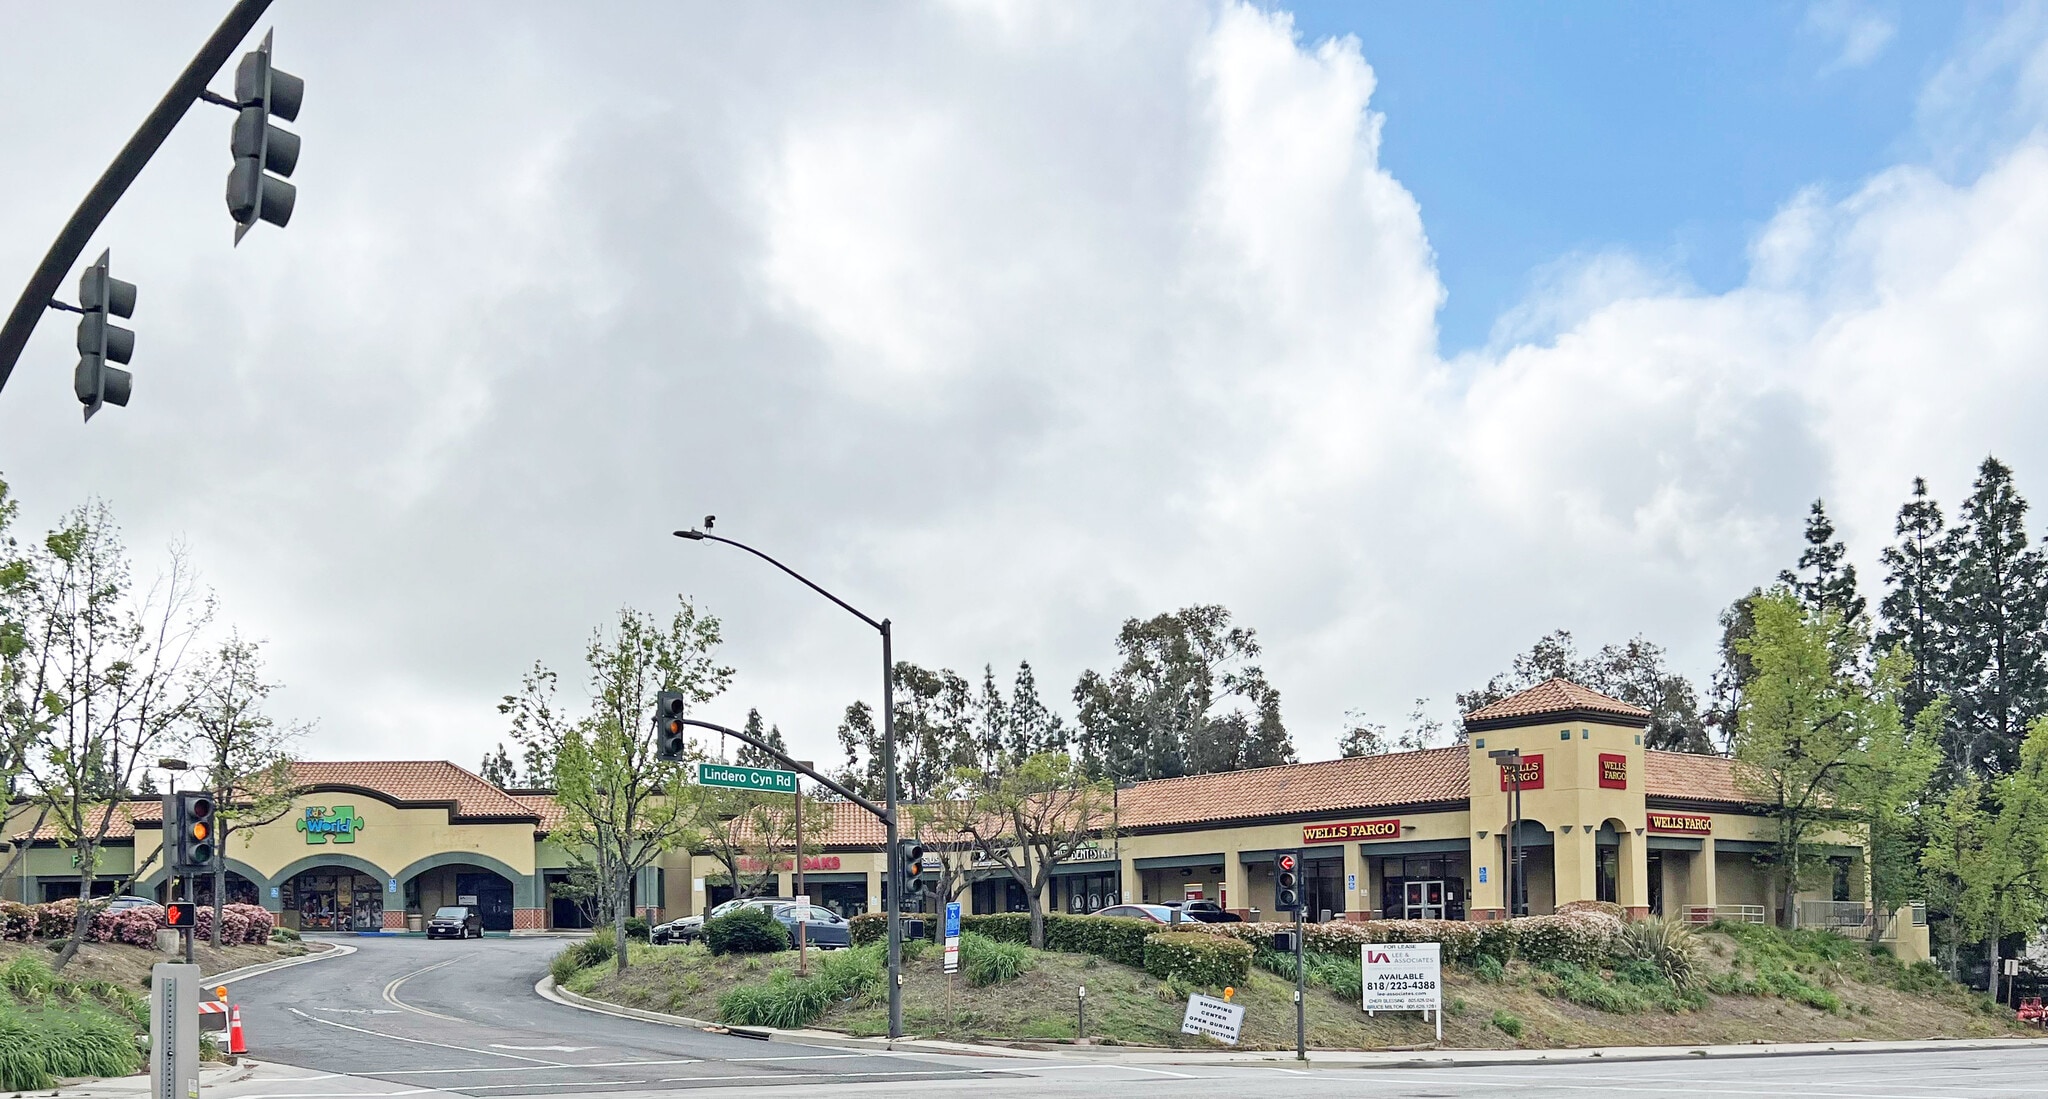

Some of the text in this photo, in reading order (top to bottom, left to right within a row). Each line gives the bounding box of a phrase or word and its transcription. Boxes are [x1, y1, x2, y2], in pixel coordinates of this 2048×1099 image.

[1603, 760, 1626, 771] WELLS
[704, 767, 791, 787] Lindero Cyn Rd
[1604, 770, 1626, 781] FARGO
[307, 818, 351, 833] World
[1303, 822, 1396, 840] WELLS FARGO
[1652, 816, 1713, 831] WELLS FARGO
[801, 856, 841, 871] OAKS
[1367, 981, 1436, 991] 818/223-4388
[1199, 1001, 1233, 1014] SHOPPING
[1200, 1010, 1228, 1021] CENTER
[1184, 1022, 1236, 1040] CONSTRUCTION
[1188, 1016, 1235, 1032] OPEN DURING
